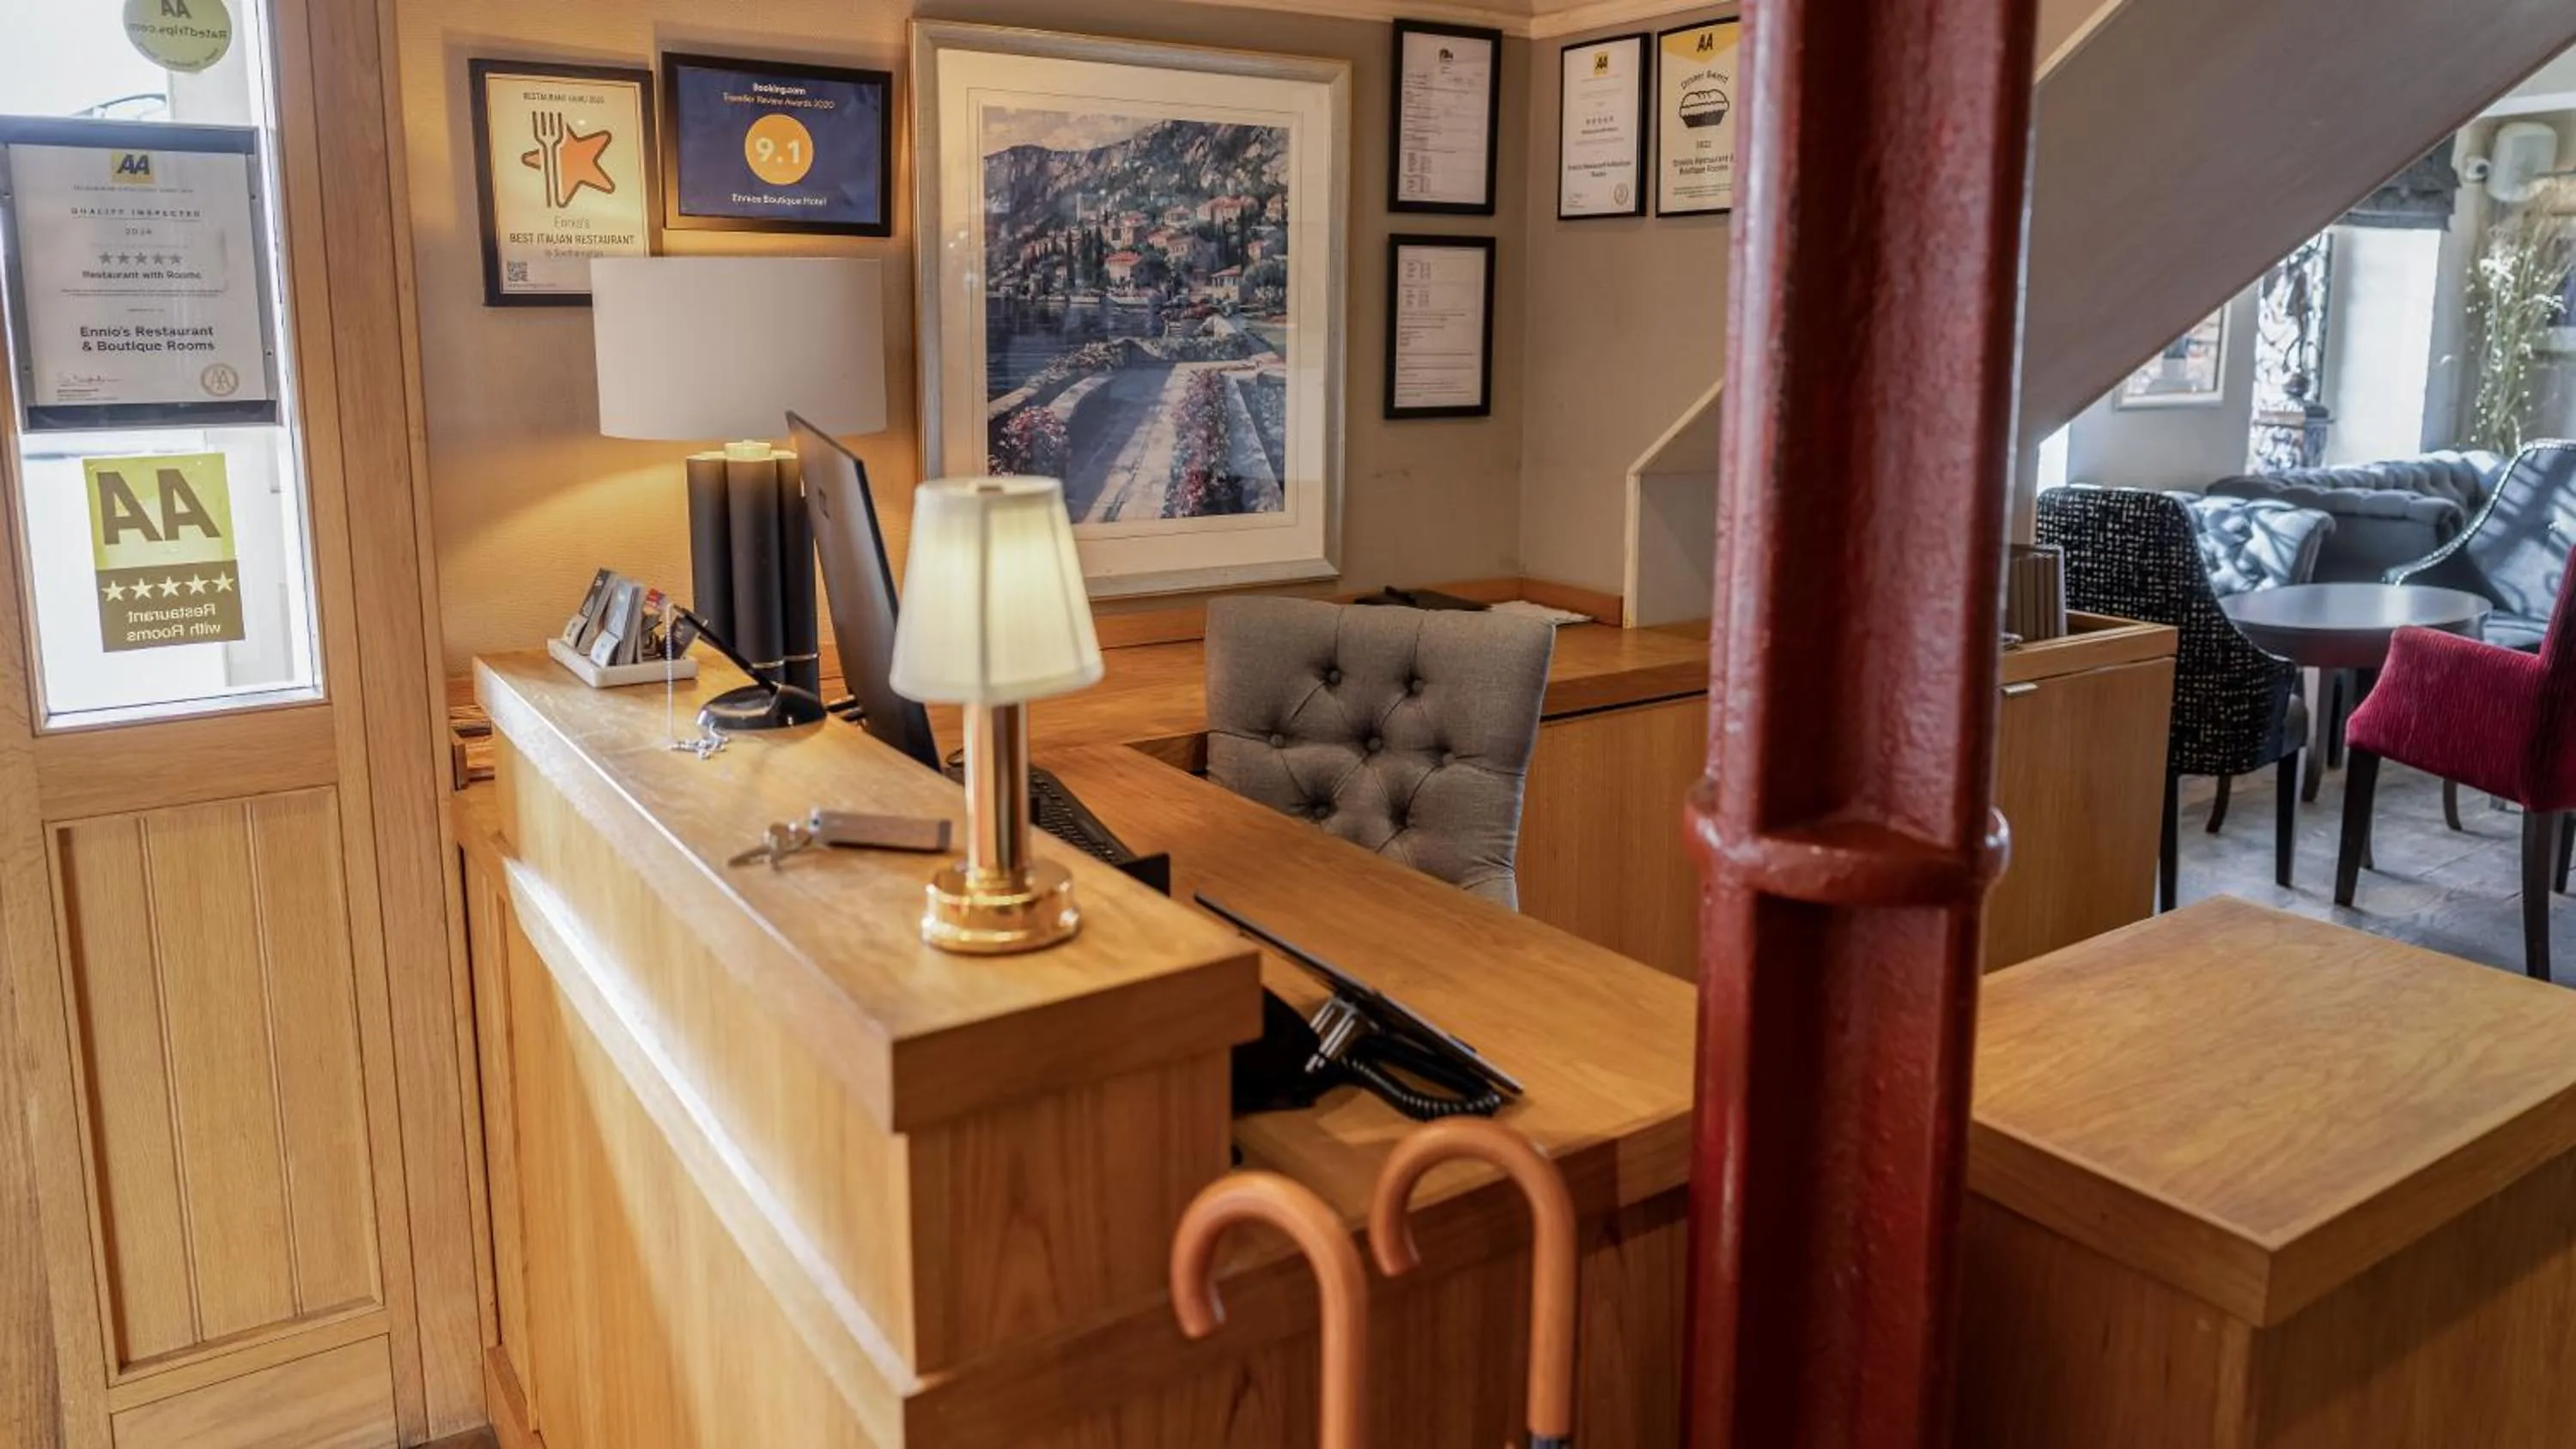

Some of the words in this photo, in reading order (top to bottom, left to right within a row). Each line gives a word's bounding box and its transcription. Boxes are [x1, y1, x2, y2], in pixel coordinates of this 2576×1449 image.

[1697, 33, 1713, 52] AA
[1595, 55, 1608, 69] AA
[752, 83, 806, 95] Booking.com
[756, 137, 800, 164] 9.1
[116, 154, 150, 175] AA
[509, 233, 534, 244] BEST
[537, 233, 572, 245] ITALIAN
[574, 234, 635, 245] RESTAURANT
[82, 270, 138, 280] Restaurant
[143, 270, 164, 280] with
[167, 270, 202, 280] Rooms
[80, 326, 131, 337] Ennio's
[135, 326, 214, 337] Restaurant
[82, 341, 92, 352] &
[97, 341, 162, 353] Boutique
[167, 341, 216, 351] Rooms
